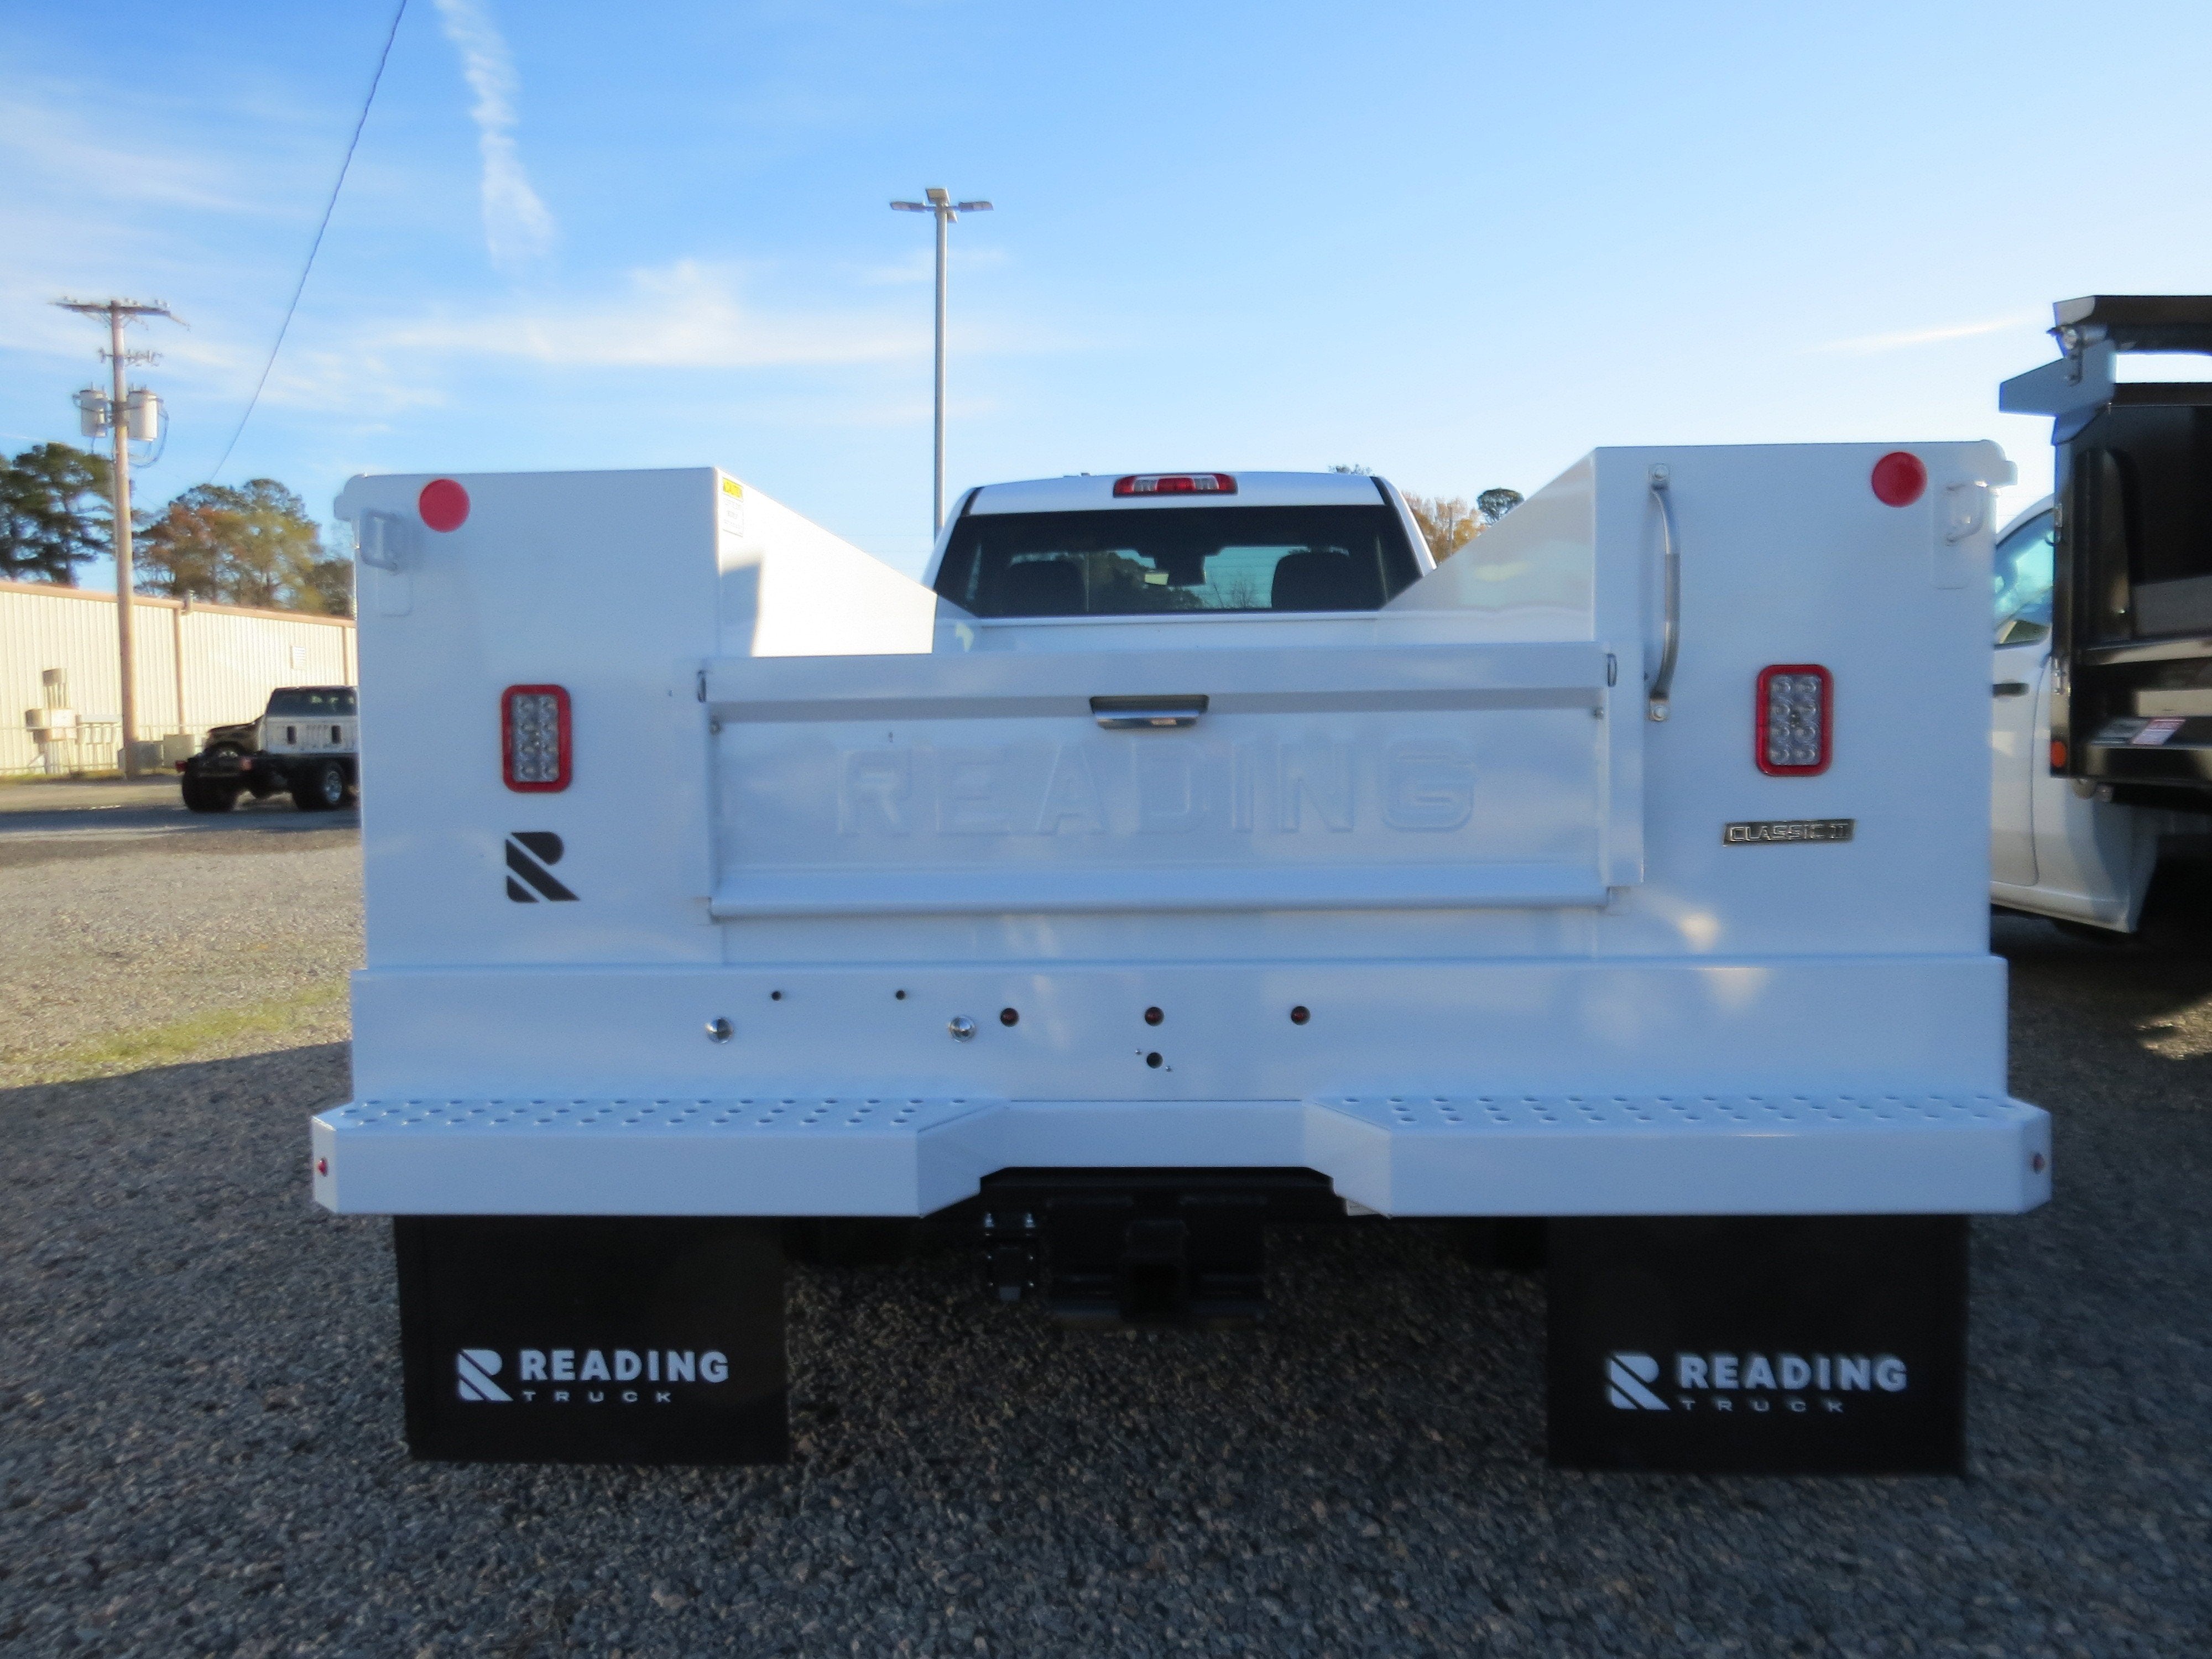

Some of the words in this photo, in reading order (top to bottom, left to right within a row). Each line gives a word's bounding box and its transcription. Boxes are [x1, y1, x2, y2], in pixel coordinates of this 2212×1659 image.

[837, 738, 1478, 837] READING
[1729, 825, 1825, 842] CLASSIC
[519, 1349, 729, 1383] READING
[1678, 1354, 1908, 1392] READING
[521, 1390, 671, 1403] TRUCK
[1680, 1398, 1844, 1413] TRUCK
